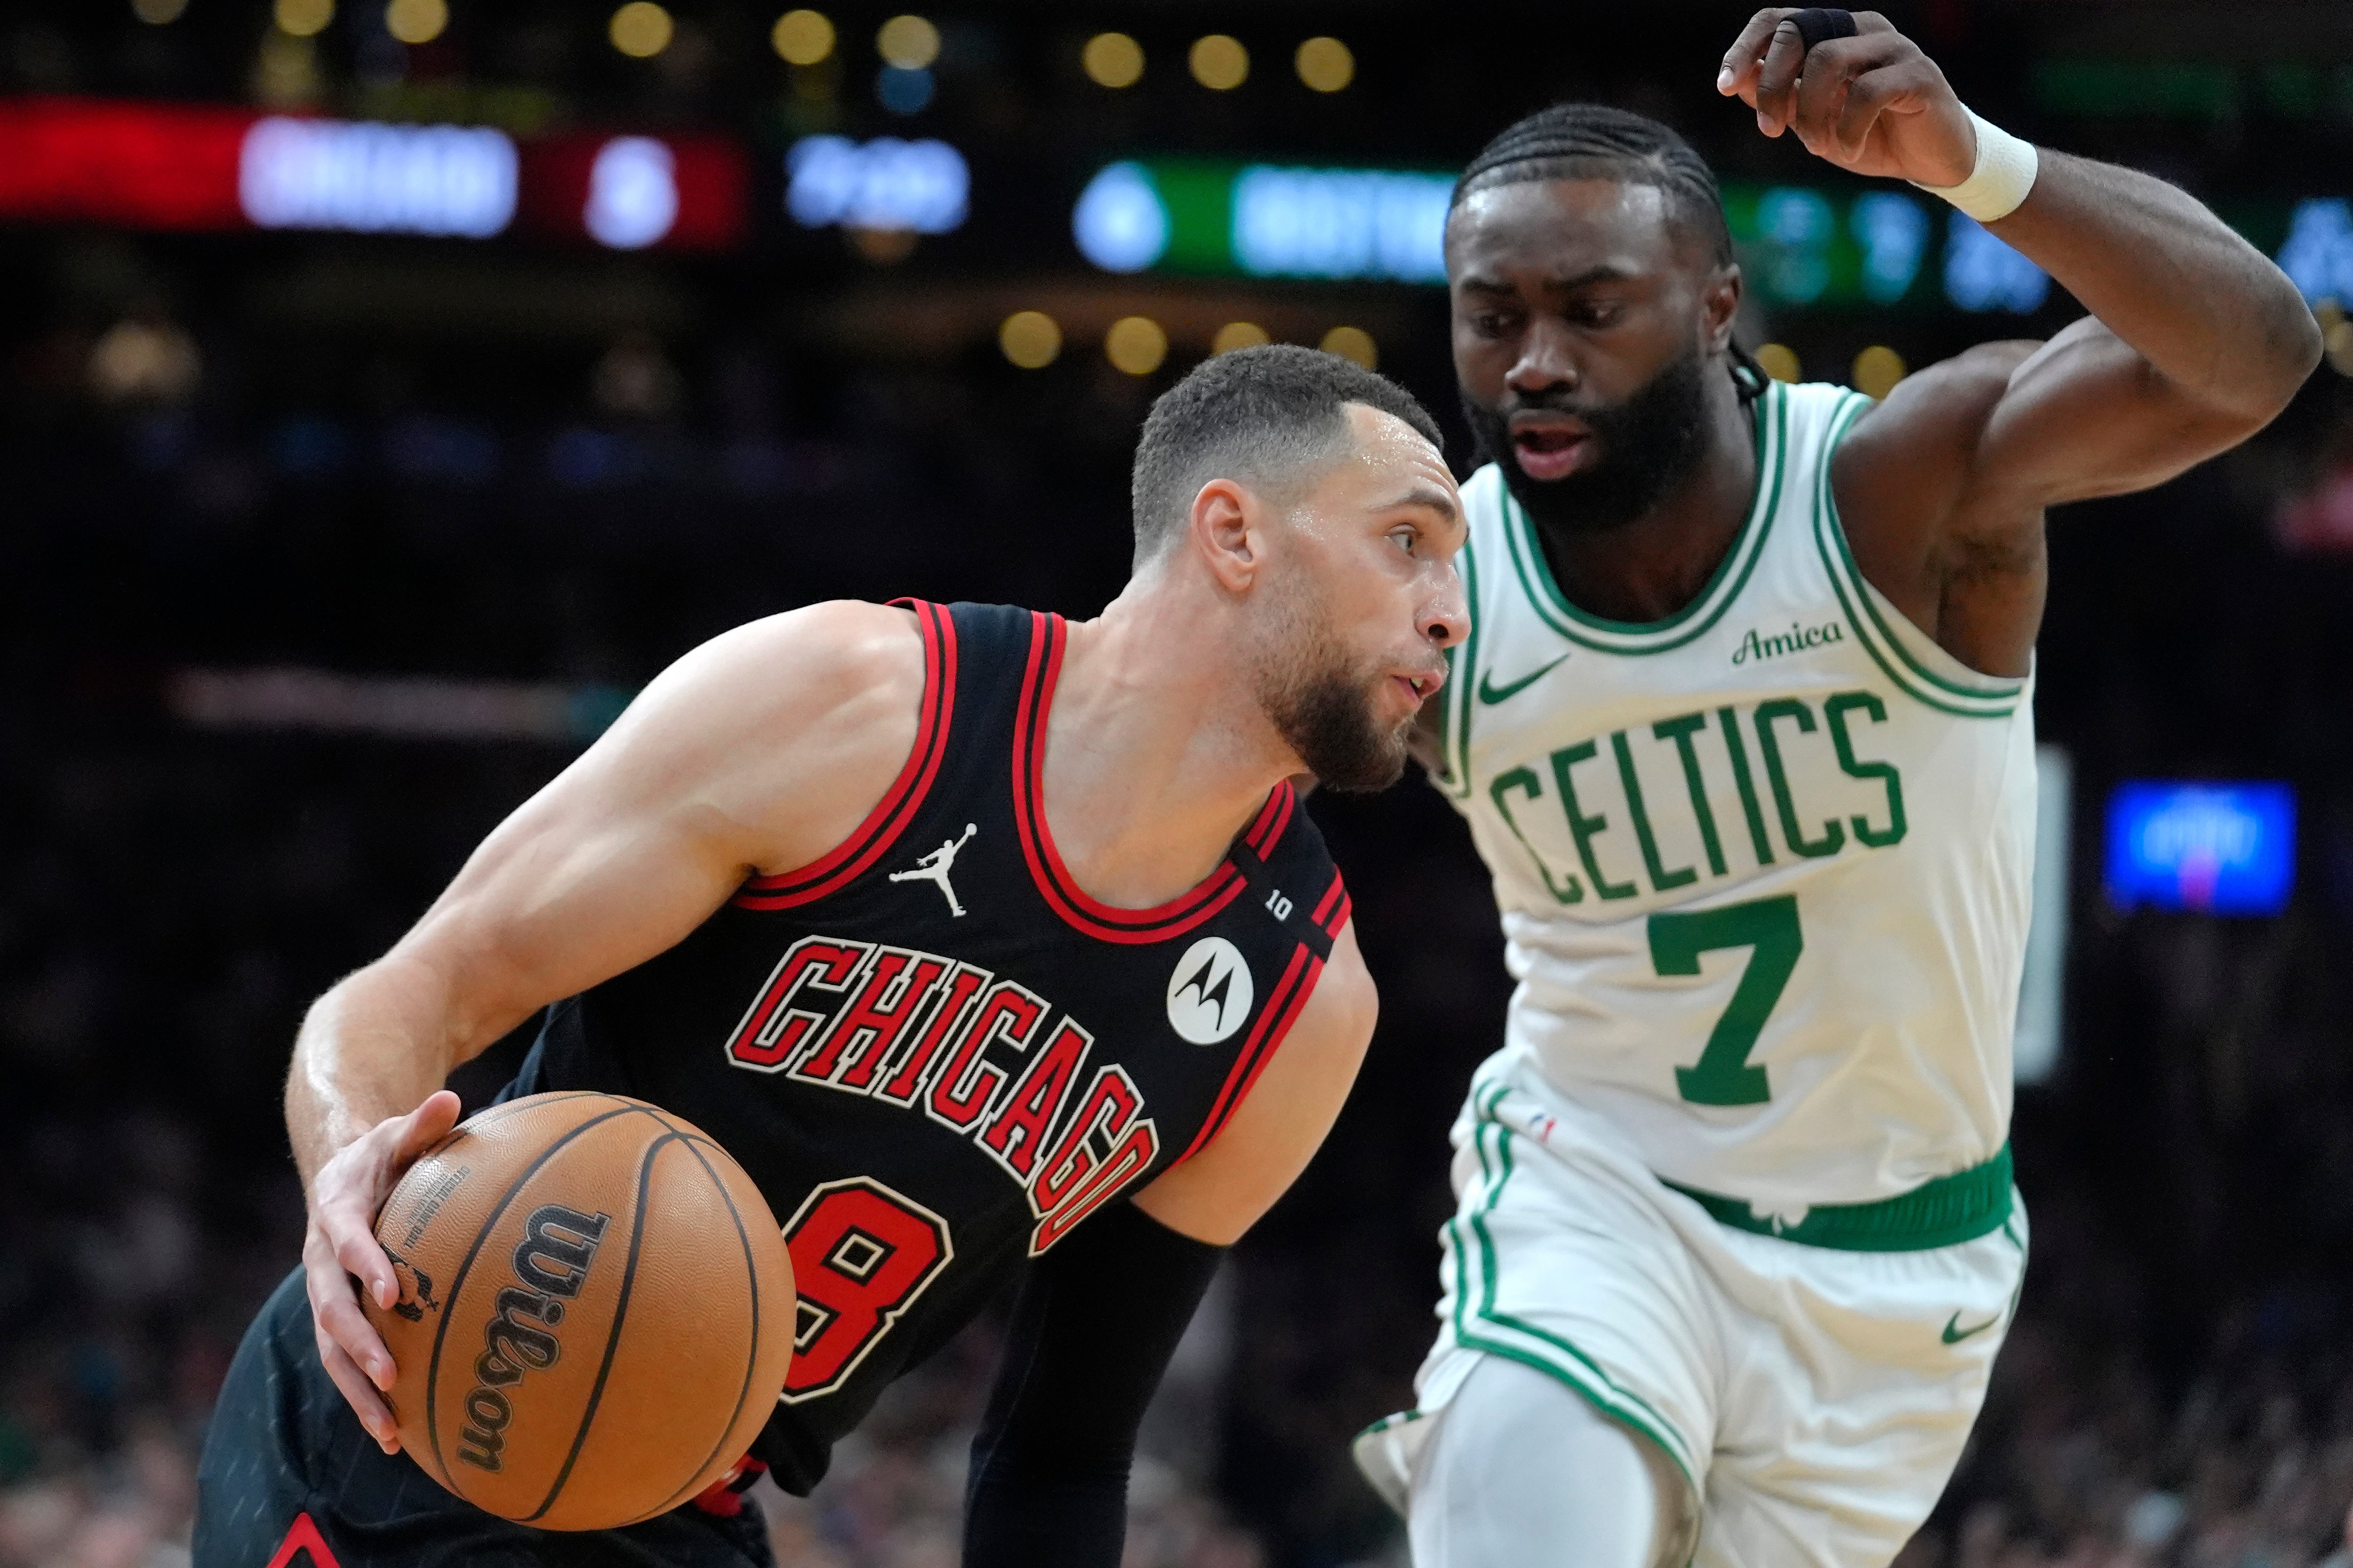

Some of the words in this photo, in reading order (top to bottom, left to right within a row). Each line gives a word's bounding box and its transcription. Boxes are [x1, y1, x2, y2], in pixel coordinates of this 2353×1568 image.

[1732, 621, 1843, 665] Amica
[1489, 691, 1907, 904] CELTICS
[1265, 889, 1293, 921] 10
[1647, 892, 1804, 1105] 7
[725, 935, 1160, 1258] CHICAGO
[457, 1204, 610, 1472] Wilson
[779, 1176, 954, 1404] 8
